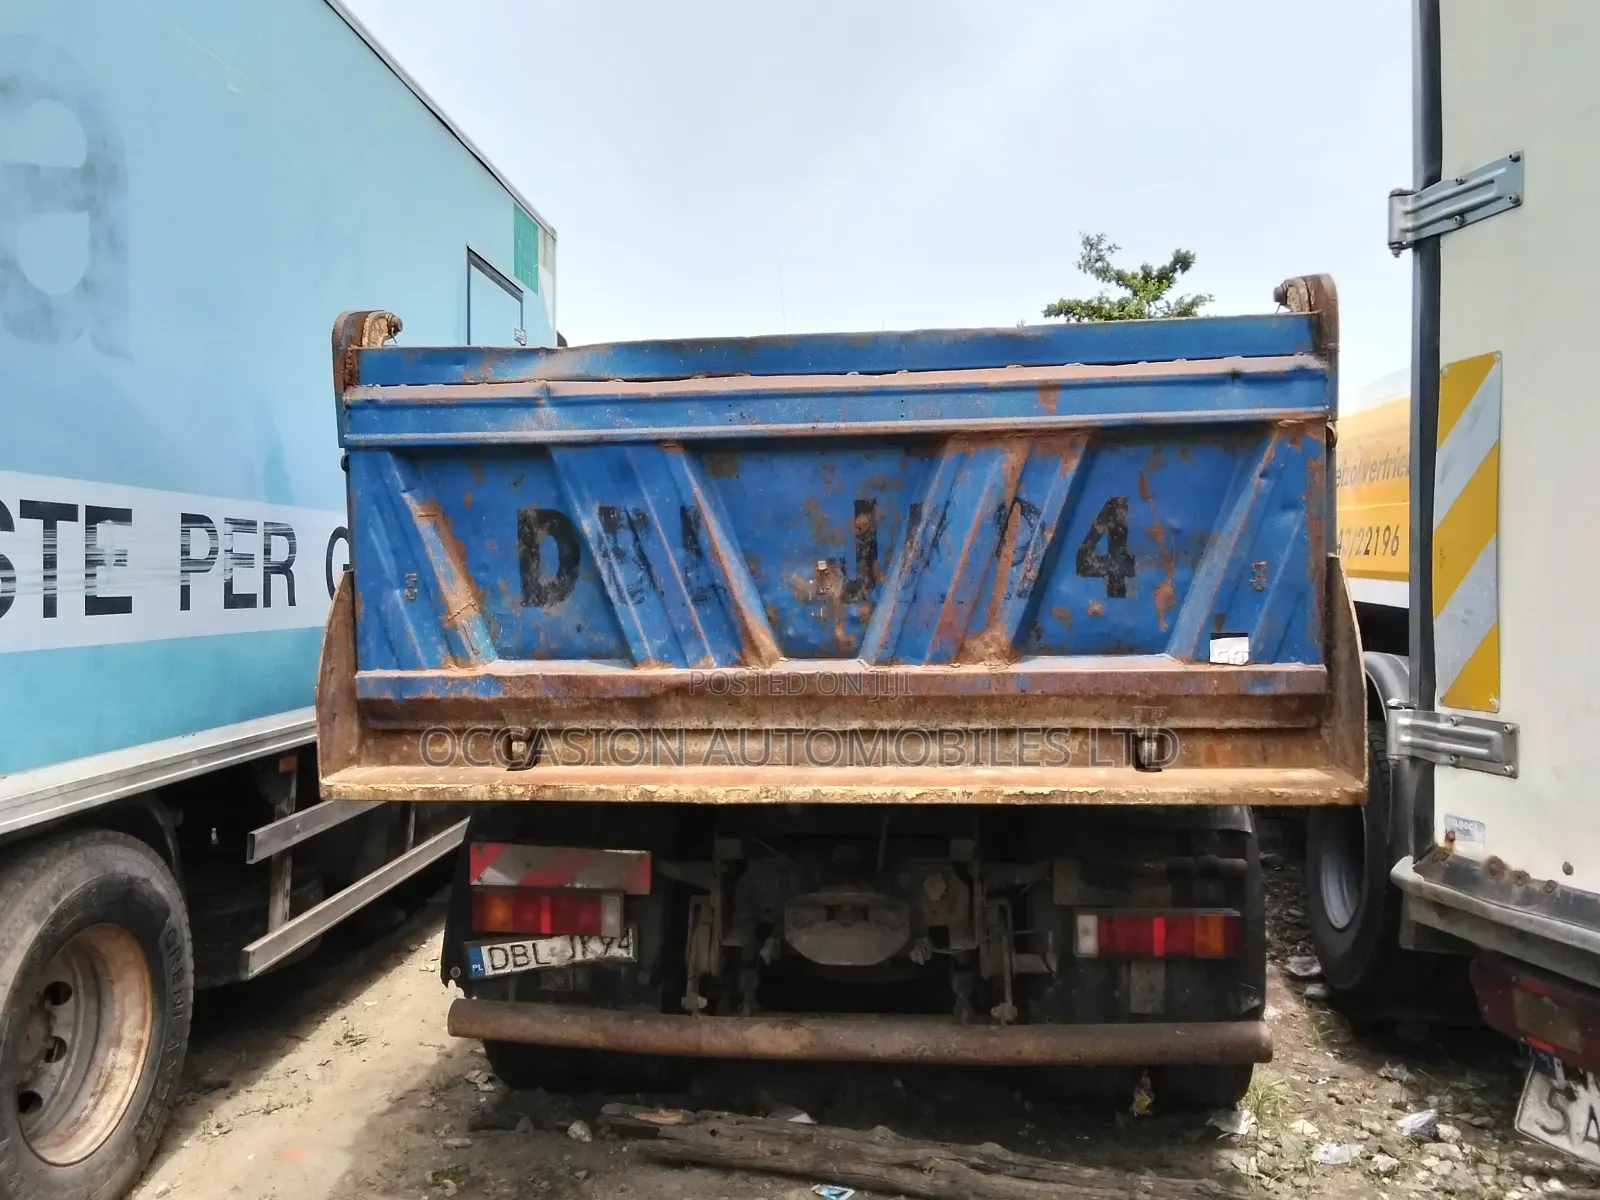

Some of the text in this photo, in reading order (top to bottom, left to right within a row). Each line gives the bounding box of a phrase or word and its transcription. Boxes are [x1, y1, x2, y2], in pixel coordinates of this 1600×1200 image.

[0, 499, 132, 619] TE
[180, 512, 297, 611] PER
[471, 963, 484, 972] PL
[487, 943, 550, 971] DBL
